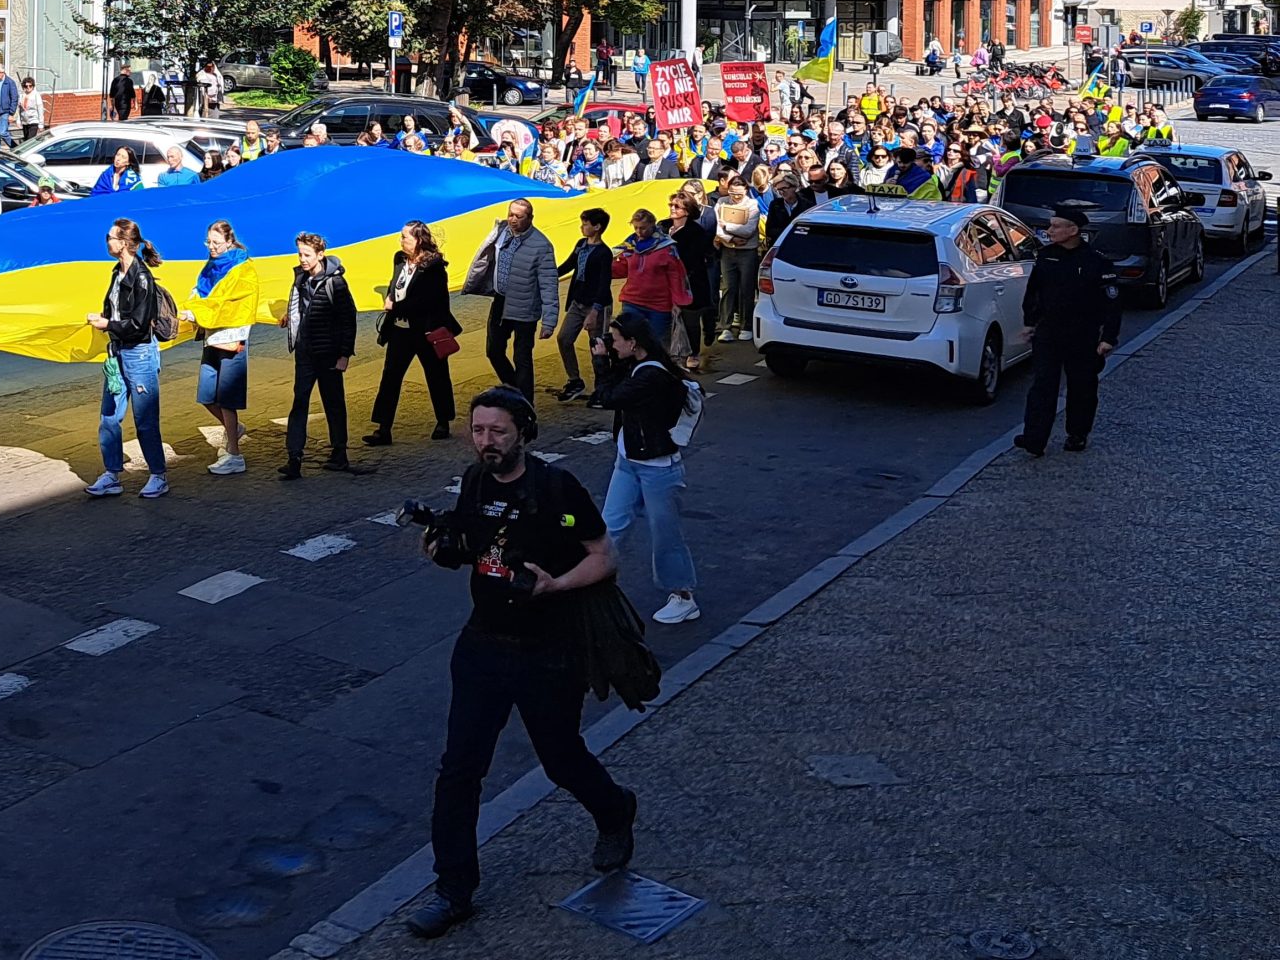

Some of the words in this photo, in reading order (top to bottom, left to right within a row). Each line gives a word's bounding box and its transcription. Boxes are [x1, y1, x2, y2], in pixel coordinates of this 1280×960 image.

[391, 13, 400, 30] P
[1142, 23, 1150, 32] P
[655, 63, 688, 82] ŻYCIE
[655, 81, 670, 97] TO
[674, 76, 695, 95] NIE
[660, 92, 695, 110] RUSKI
[667, 107, 693, 124] MIR
[871, 185, 899, 195] TAXI
[825, 292, 841, 304] GD
[845, 294, 881, 308] 7S139
